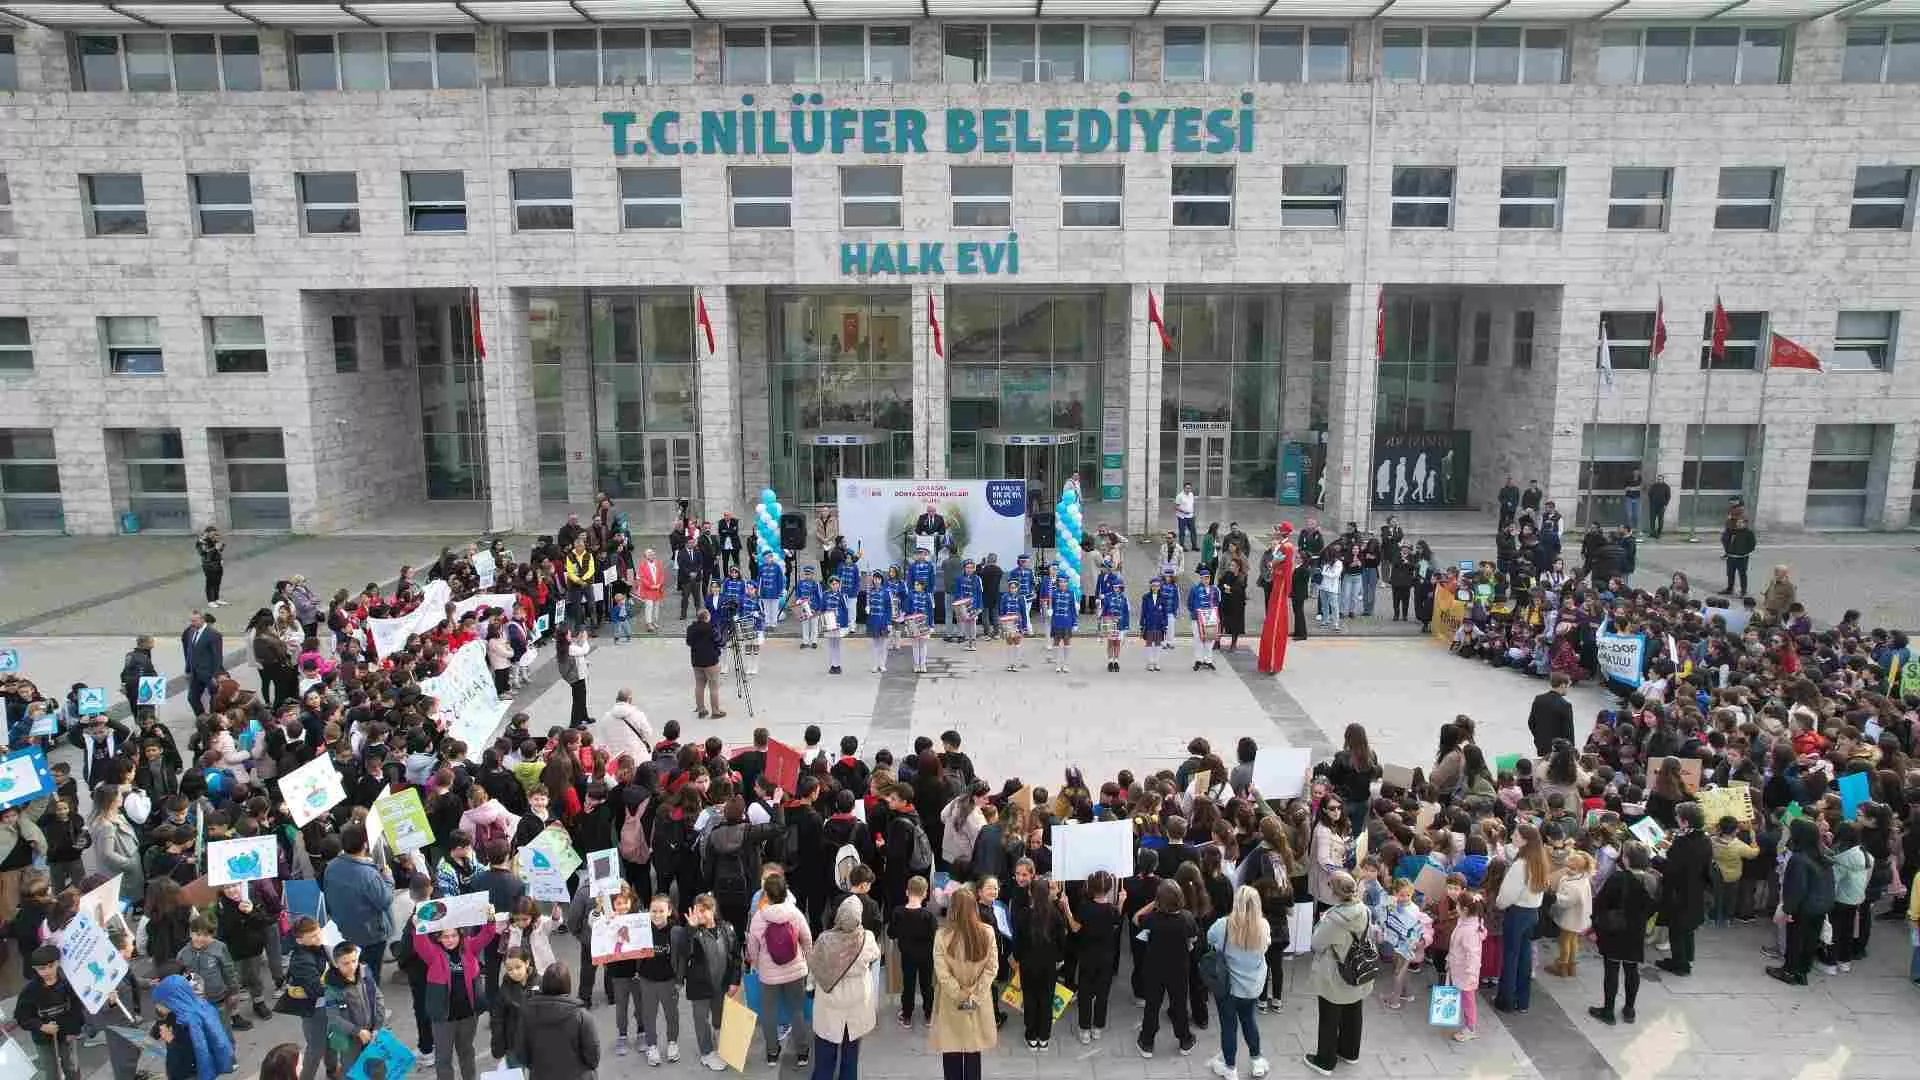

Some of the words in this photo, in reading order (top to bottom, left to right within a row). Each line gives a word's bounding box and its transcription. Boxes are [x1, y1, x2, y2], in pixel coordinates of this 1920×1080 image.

[946, 91, 1255, 154] BELEDİYESİ
[840, 242, 945, 274] HALK
[957, 233, 1020, 274] EVİ
